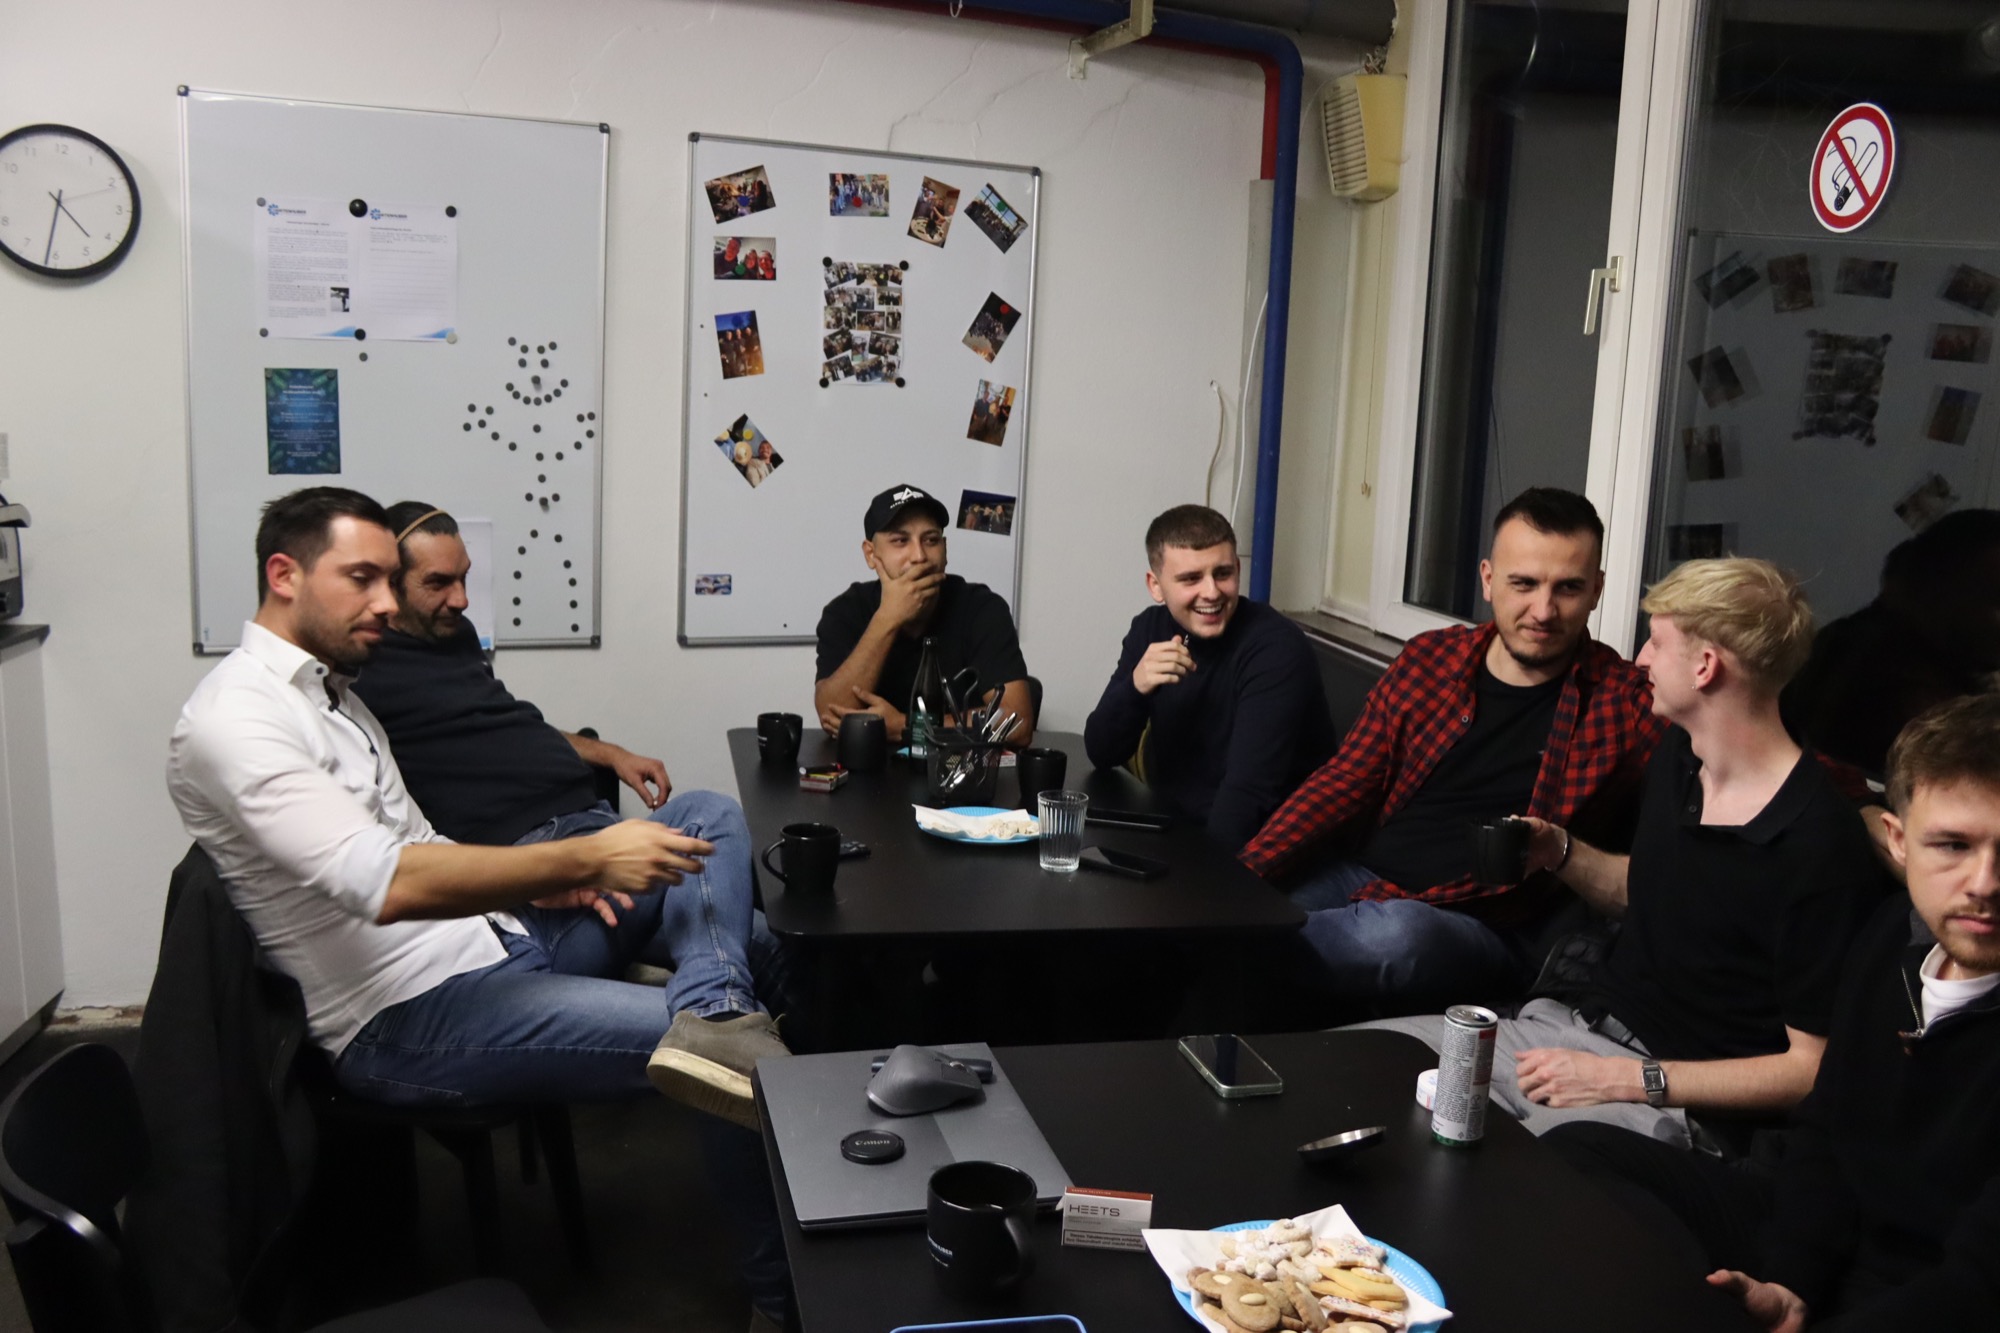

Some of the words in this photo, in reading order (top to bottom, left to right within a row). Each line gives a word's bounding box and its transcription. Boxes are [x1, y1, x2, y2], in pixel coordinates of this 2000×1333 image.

[24, 146, 37, 157] 11
[55, 143, 69, 155] 12
[4, 163, 18, 174] 10
[115, 205, 123, 216] 3
[24, 236, 31, 247] 7
[104, 232, 112, 241] 4
[52, 250, 60, 260] 6
[82, 246, 90, 257] 5
[1069, 1204, 1120, 1217] HEETS
